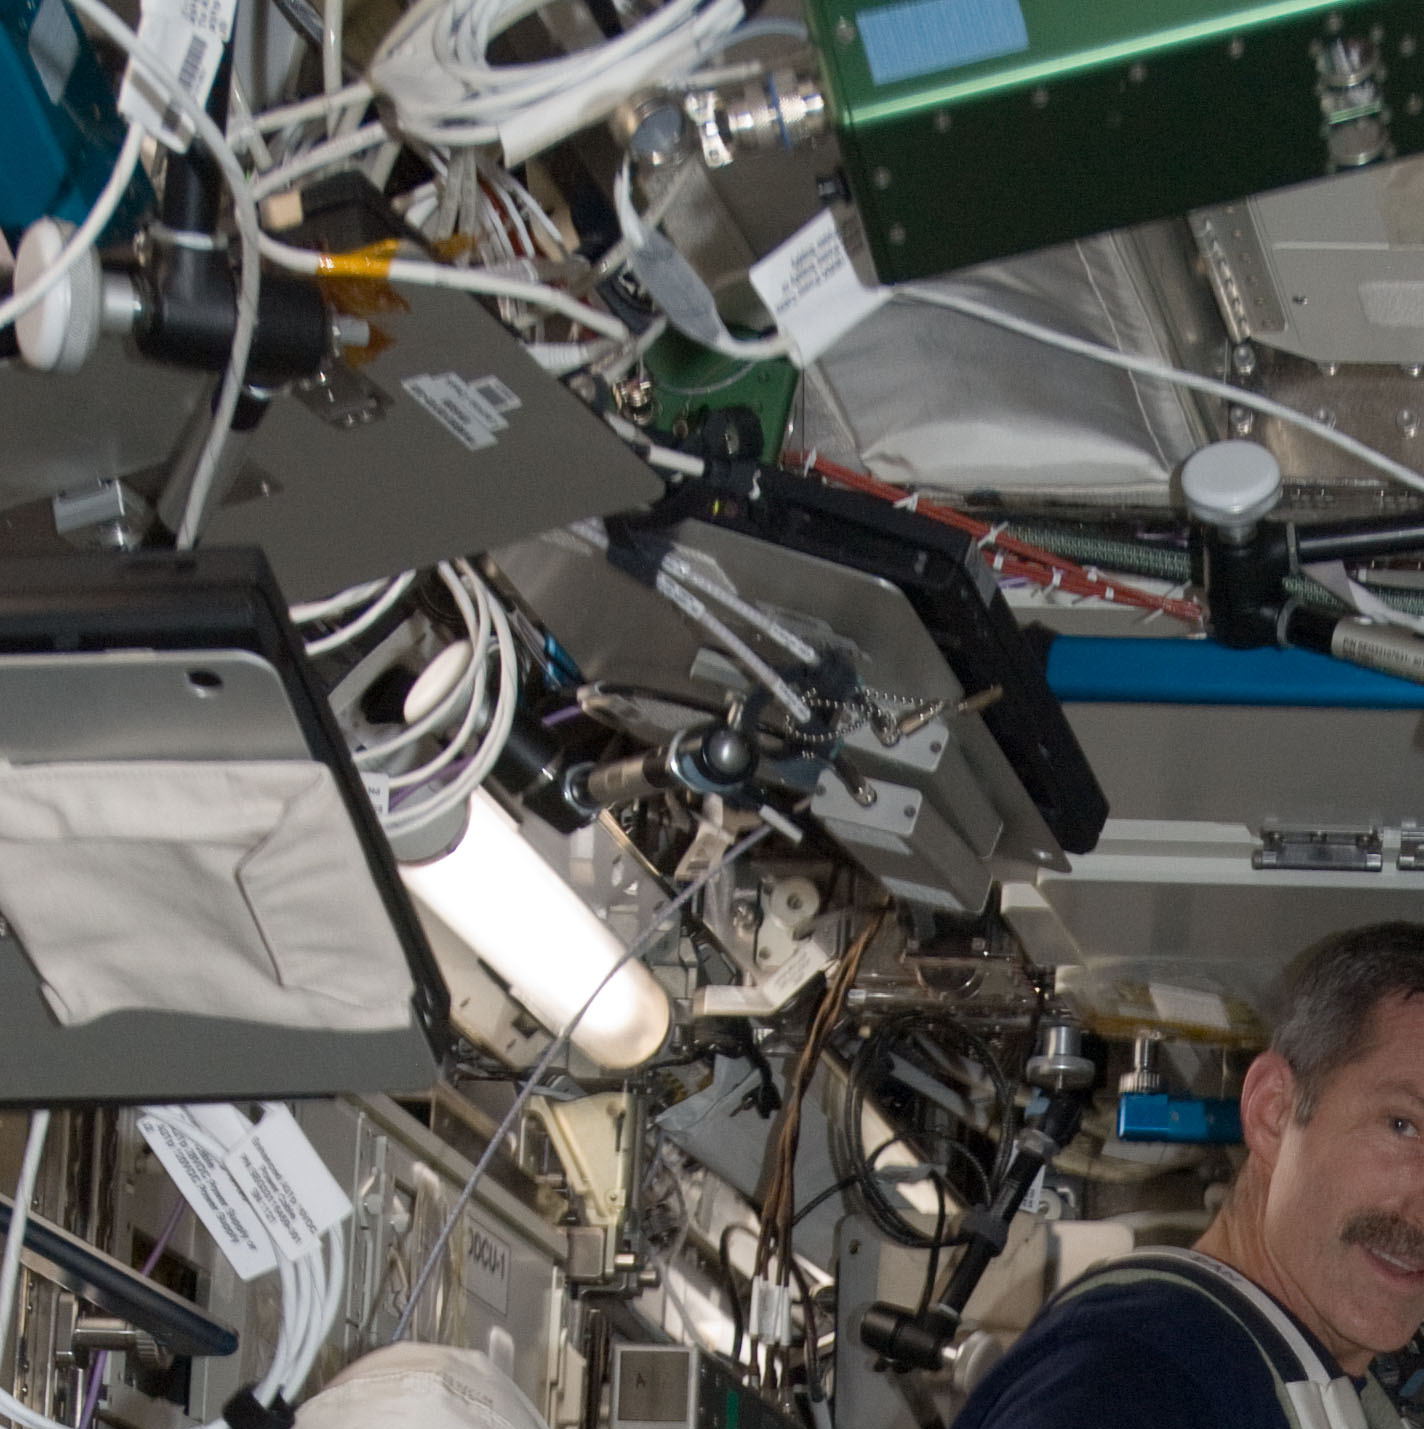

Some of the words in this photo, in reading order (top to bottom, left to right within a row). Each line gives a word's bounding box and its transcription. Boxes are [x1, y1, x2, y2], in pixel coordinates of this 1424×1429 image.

[196, 1182, 220, 1213] Power
[214, 1211, 240, 1245] Supply
[205, 1177, 230, 1208] Power
[224, 1207, 249, 1239] Supply
[258, 1165, 280, 1194] Power
[276, 1193, 297, 1220] Cable
